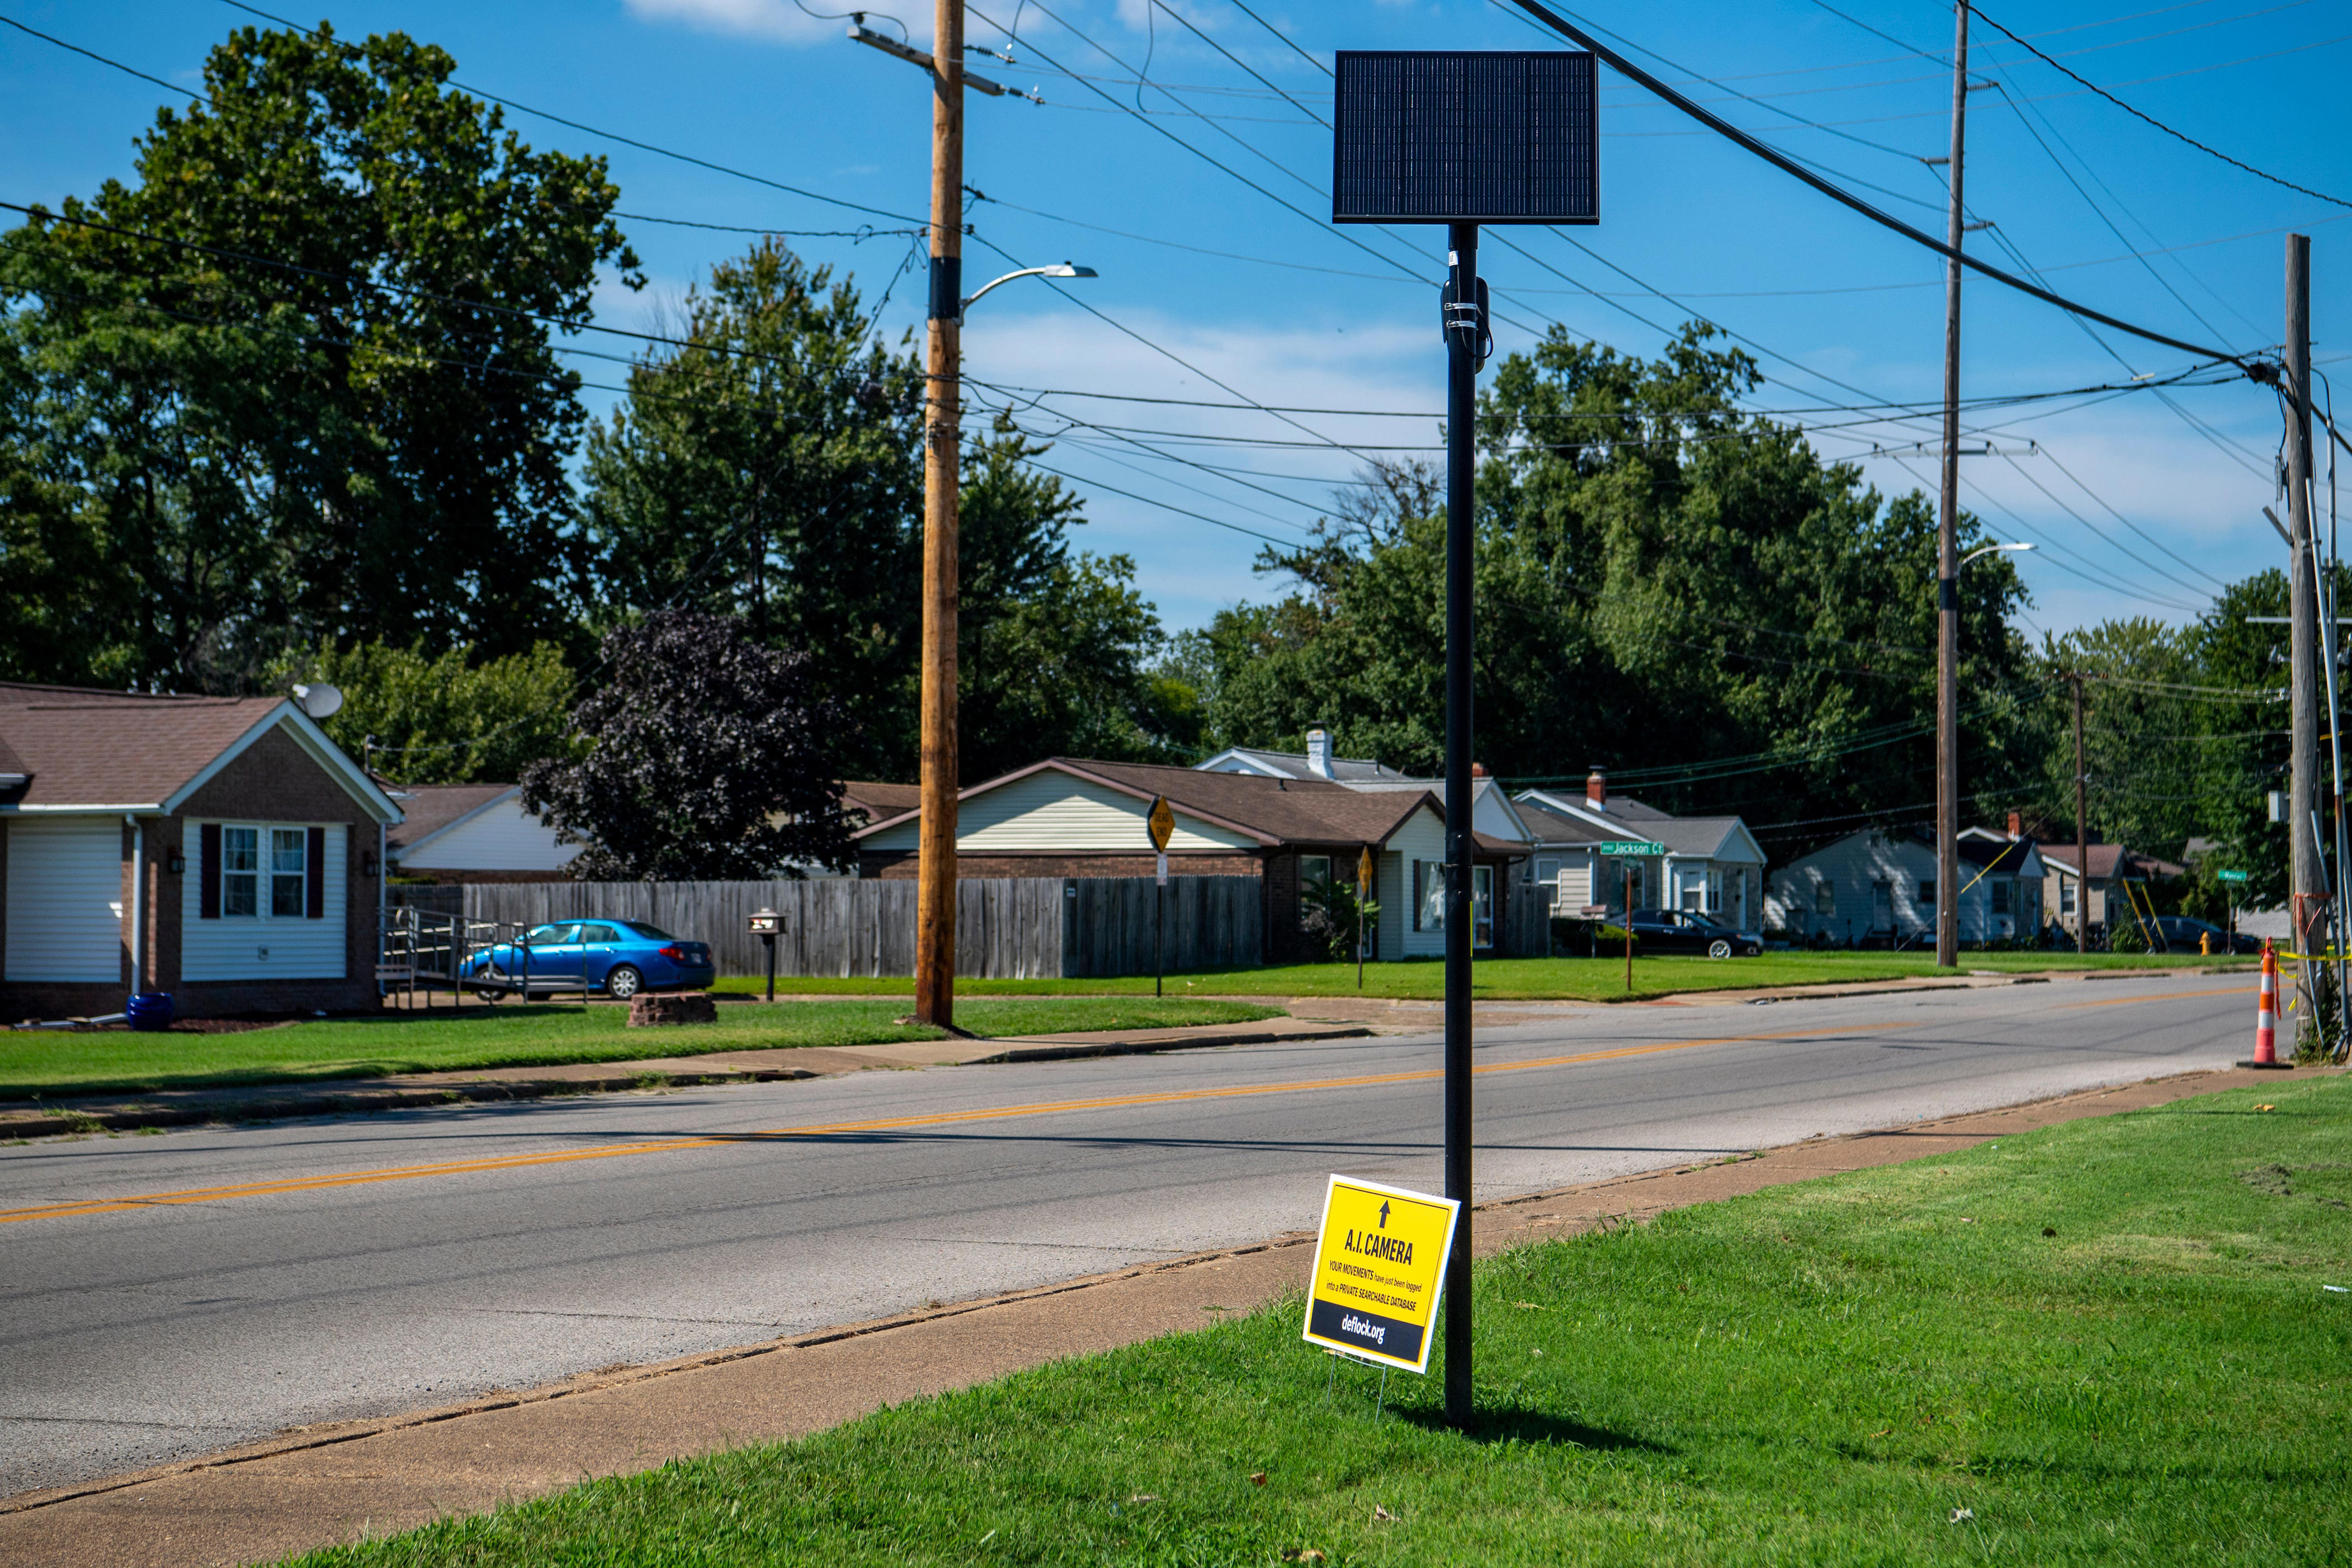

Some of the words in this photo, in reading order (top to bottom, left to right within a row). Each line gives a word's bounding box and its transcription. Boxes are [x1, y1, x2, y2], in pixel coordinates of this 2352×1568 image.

[1155, 813, 1169, 823] DEAD
[1156, 828, 1167, 837] END
[1613, 842, 1649, 854] Jackson
[1344, 1229, 1362, 1254] A.I.
[1364, 1233, 1413, 1265] CAMERA
[1329, 1260, 1342, 1273] YOUR
[1342, 1263, 1374, 1281] MOVEMENTS
[1374, 1273, 1384, 1283] have
[1384, 1275, 1394, 1286] just
[1394, 1278, 1405, 1288] been
[1405, 1280, 1423, 1293] logged
[1326, 1280, 1335, 1291] into
[1339, 1283, 1359, 1297] PRIVATE
[1358, 1288, 1391, 1305] SEARCHABLE
[1390, 1296, 1417, 1311] DATABASE
[1342, 1314, 1386, 1344] deflock.org
